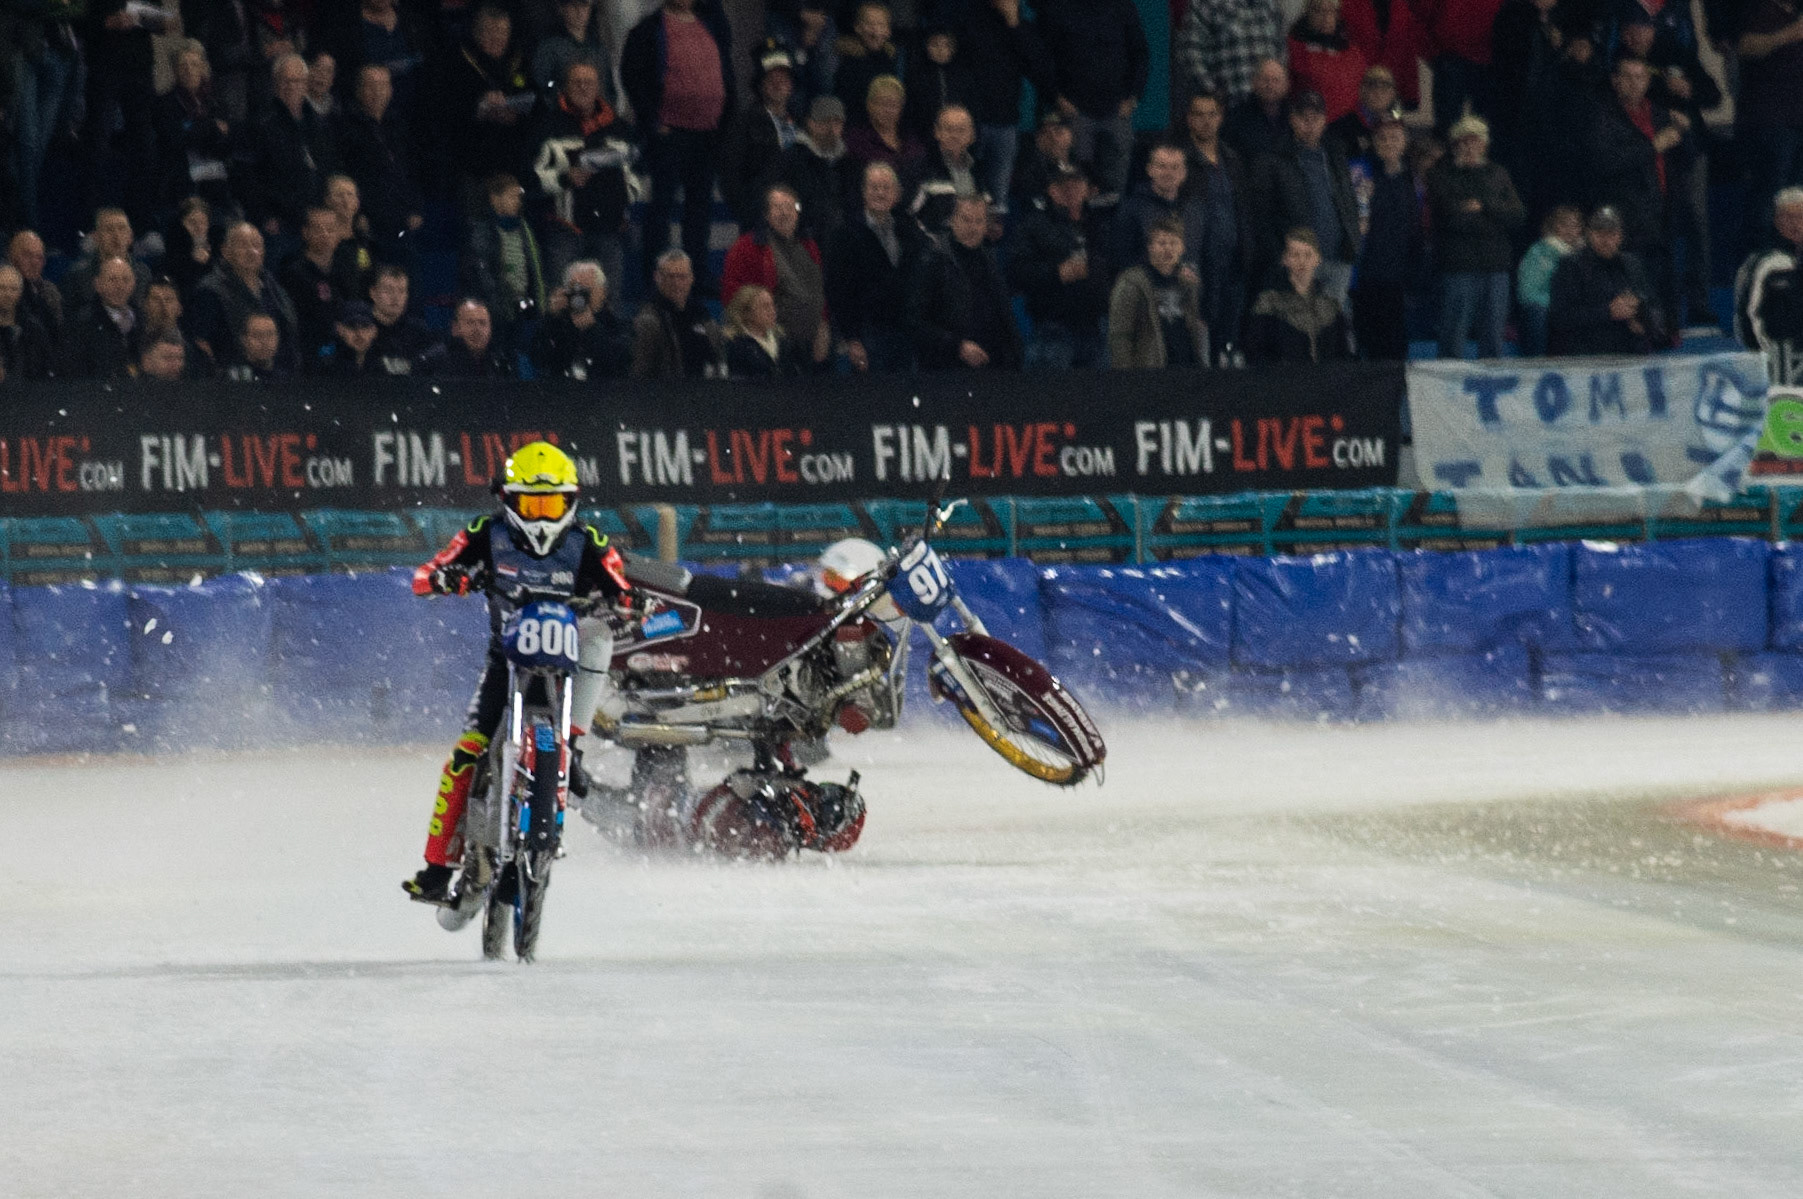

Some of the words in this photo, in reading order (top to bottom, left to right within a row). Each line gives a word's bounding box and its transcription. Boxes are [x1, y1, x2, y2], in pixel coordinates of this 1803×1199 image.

[1461, 366, 1668, 426] TOMI
[908, 546, 948, 605] 97
[516, 618, 579, 662] 800
